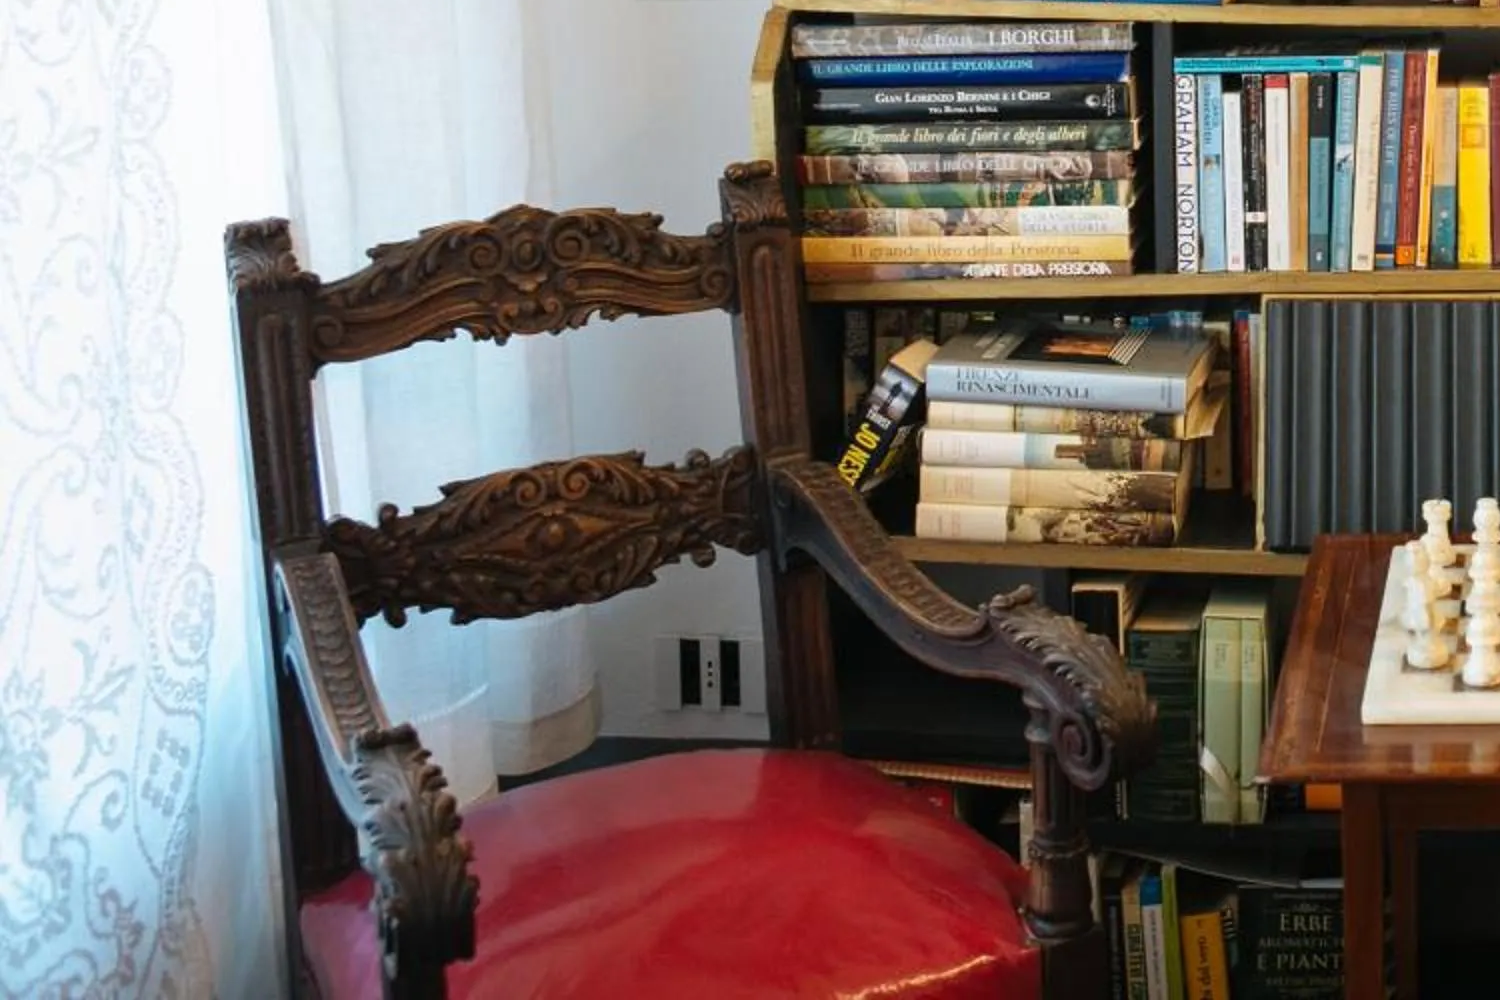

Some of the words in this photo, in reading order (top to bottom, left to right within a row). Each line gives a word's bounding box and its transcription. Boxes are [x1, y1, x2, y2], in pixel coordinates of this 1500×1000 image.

[1000, 28, 1077, 46] BORGHI
[826, 63, 873, 74] GRANDE
[1176, 74, 1194, 168] GRAHAM
[914, 127, 944, 142] libro
[947, 126, 969, 142] dei
[969, 126, 999, 146] fiori
[1013, 127, 1046, 145] degli
[1178, 183, 1196, 272] NORTON
[868, 244, 921, 259] grande
[927, 242, 964, 257] libro
[967, 242, 1003, 256] della
[956, 380, 1092, 399] RINASCIMENTALE
[855, 422, 881, 450] JO
[836, 443, 871, 488] NES
[1280, 913, 1330, 932] ERBE
[1277, 953, 1342, 970] PIANT
